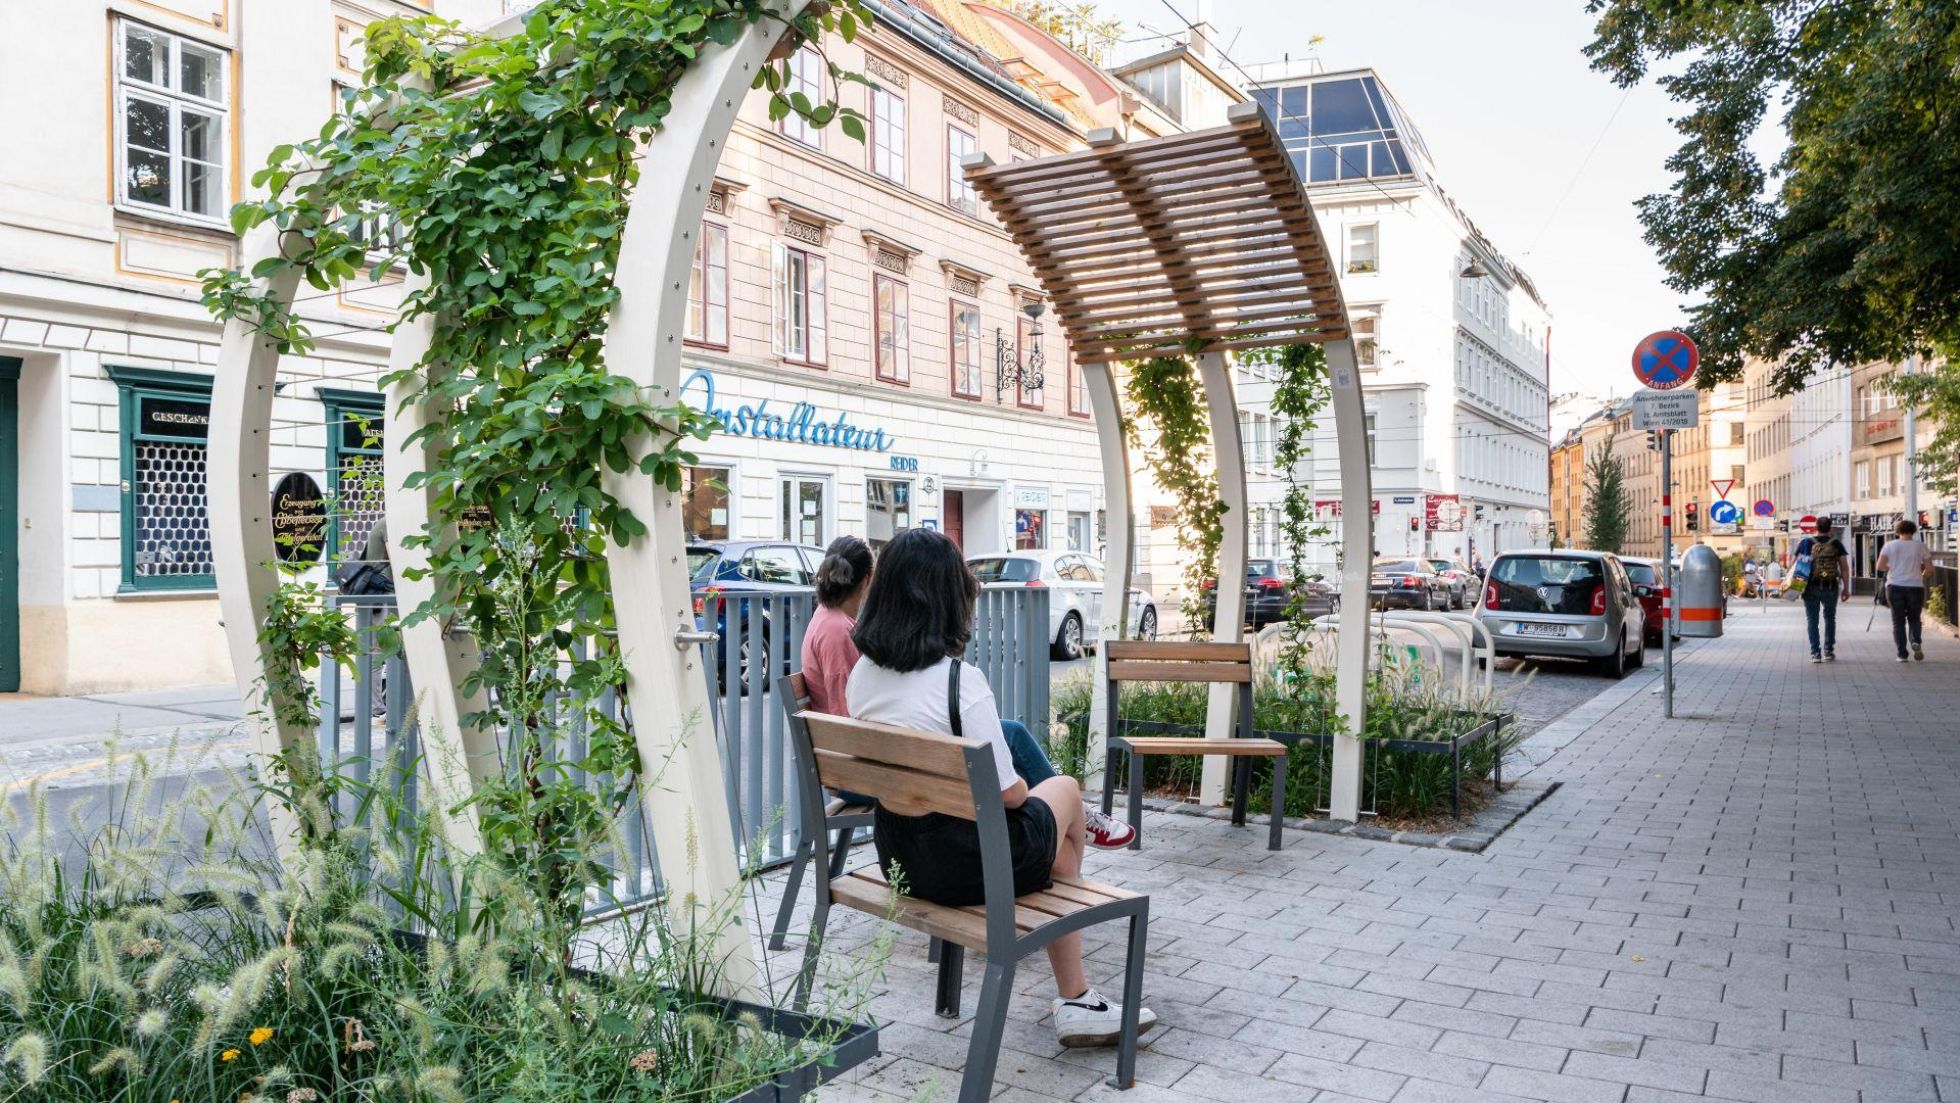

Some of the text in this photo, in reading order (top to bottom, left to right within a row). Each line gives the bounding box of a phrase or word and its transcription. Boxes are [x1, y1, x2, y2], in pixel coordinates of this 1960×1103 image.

[1647, 377, 1684, 389] ANFANG
[1635, 393, 1696, 402] Anwohnerparken
[680, 368, 895, 452] Installateur
[890, 455, 918, 472] REIDER
